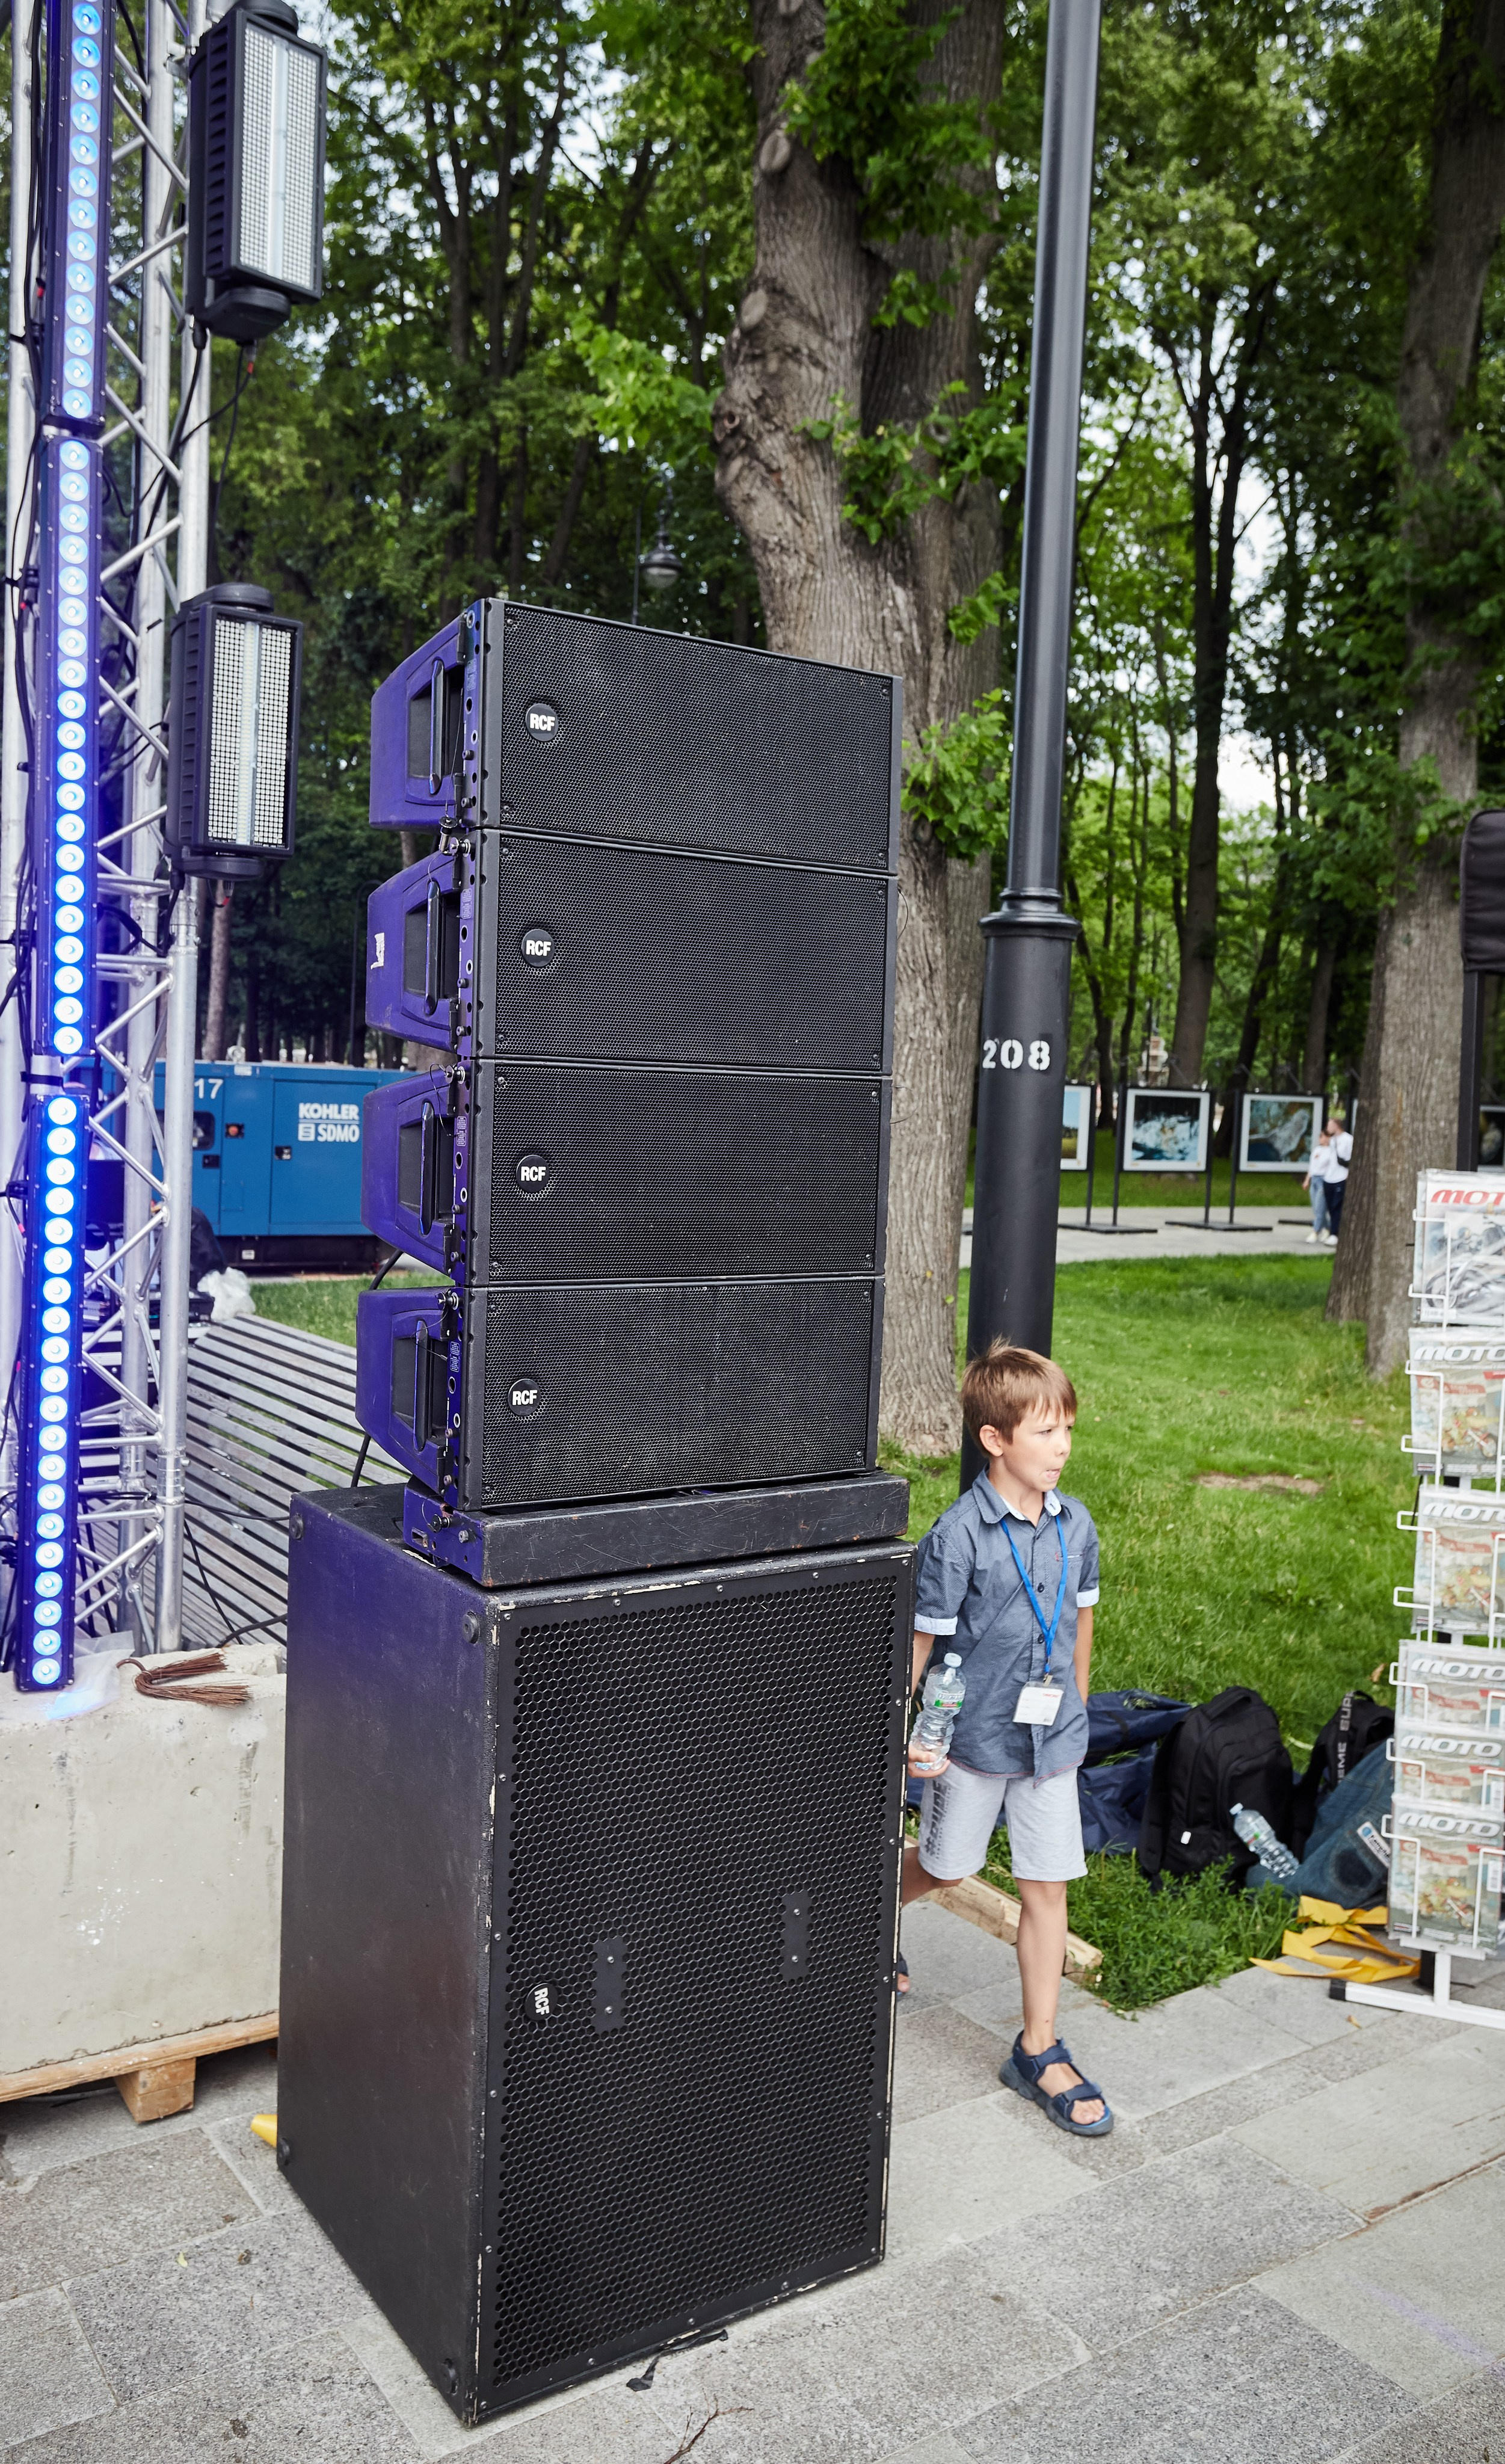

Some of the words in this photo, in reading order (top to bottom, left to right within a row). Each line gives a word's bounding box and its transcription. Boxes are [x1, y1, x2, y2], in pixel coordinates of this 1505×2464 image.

[530, 713, 555, 731] RCF
[526, 940, 552, 956] RCF
[982, 1039, 1050, 1070] 208
[194, 1078, 223, 1099] 17
[298, 1103, 359, 1120] KOHLER
[317, 1124, 360, 1142] SDMO
[521, 1166, 546, 1181] RCF
[512, 1390, 538, 1405] RCF
[1399, 1735, 1503, 1758] MOTO
[1398, 1812, 1501, 1838] MOTO
[534, 1988, 550, 2015] RCF
